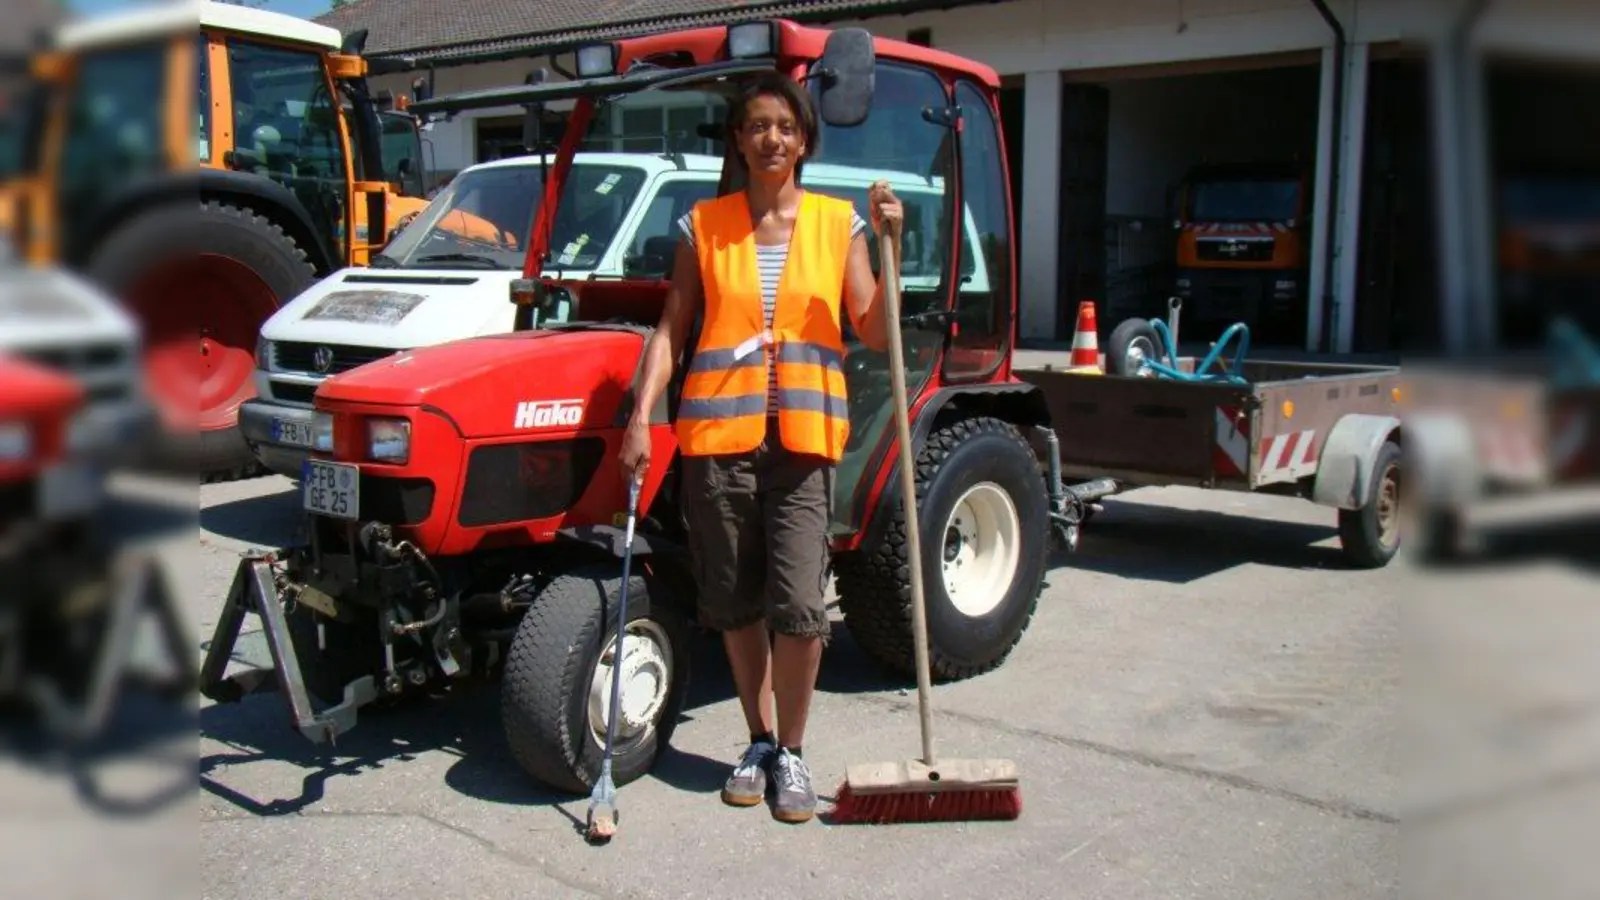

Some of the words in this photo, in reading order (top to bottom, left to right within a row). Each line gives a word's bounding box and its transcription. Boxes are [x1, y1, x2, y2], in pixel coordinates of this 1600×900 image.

[514, 399, 584, 428] Hako
[280, 421, 297, 441] FFB
[311, 464, 336, 489] FFB
[311, 486, 327, 510] GE
[331, 490, 348, 513] 25
